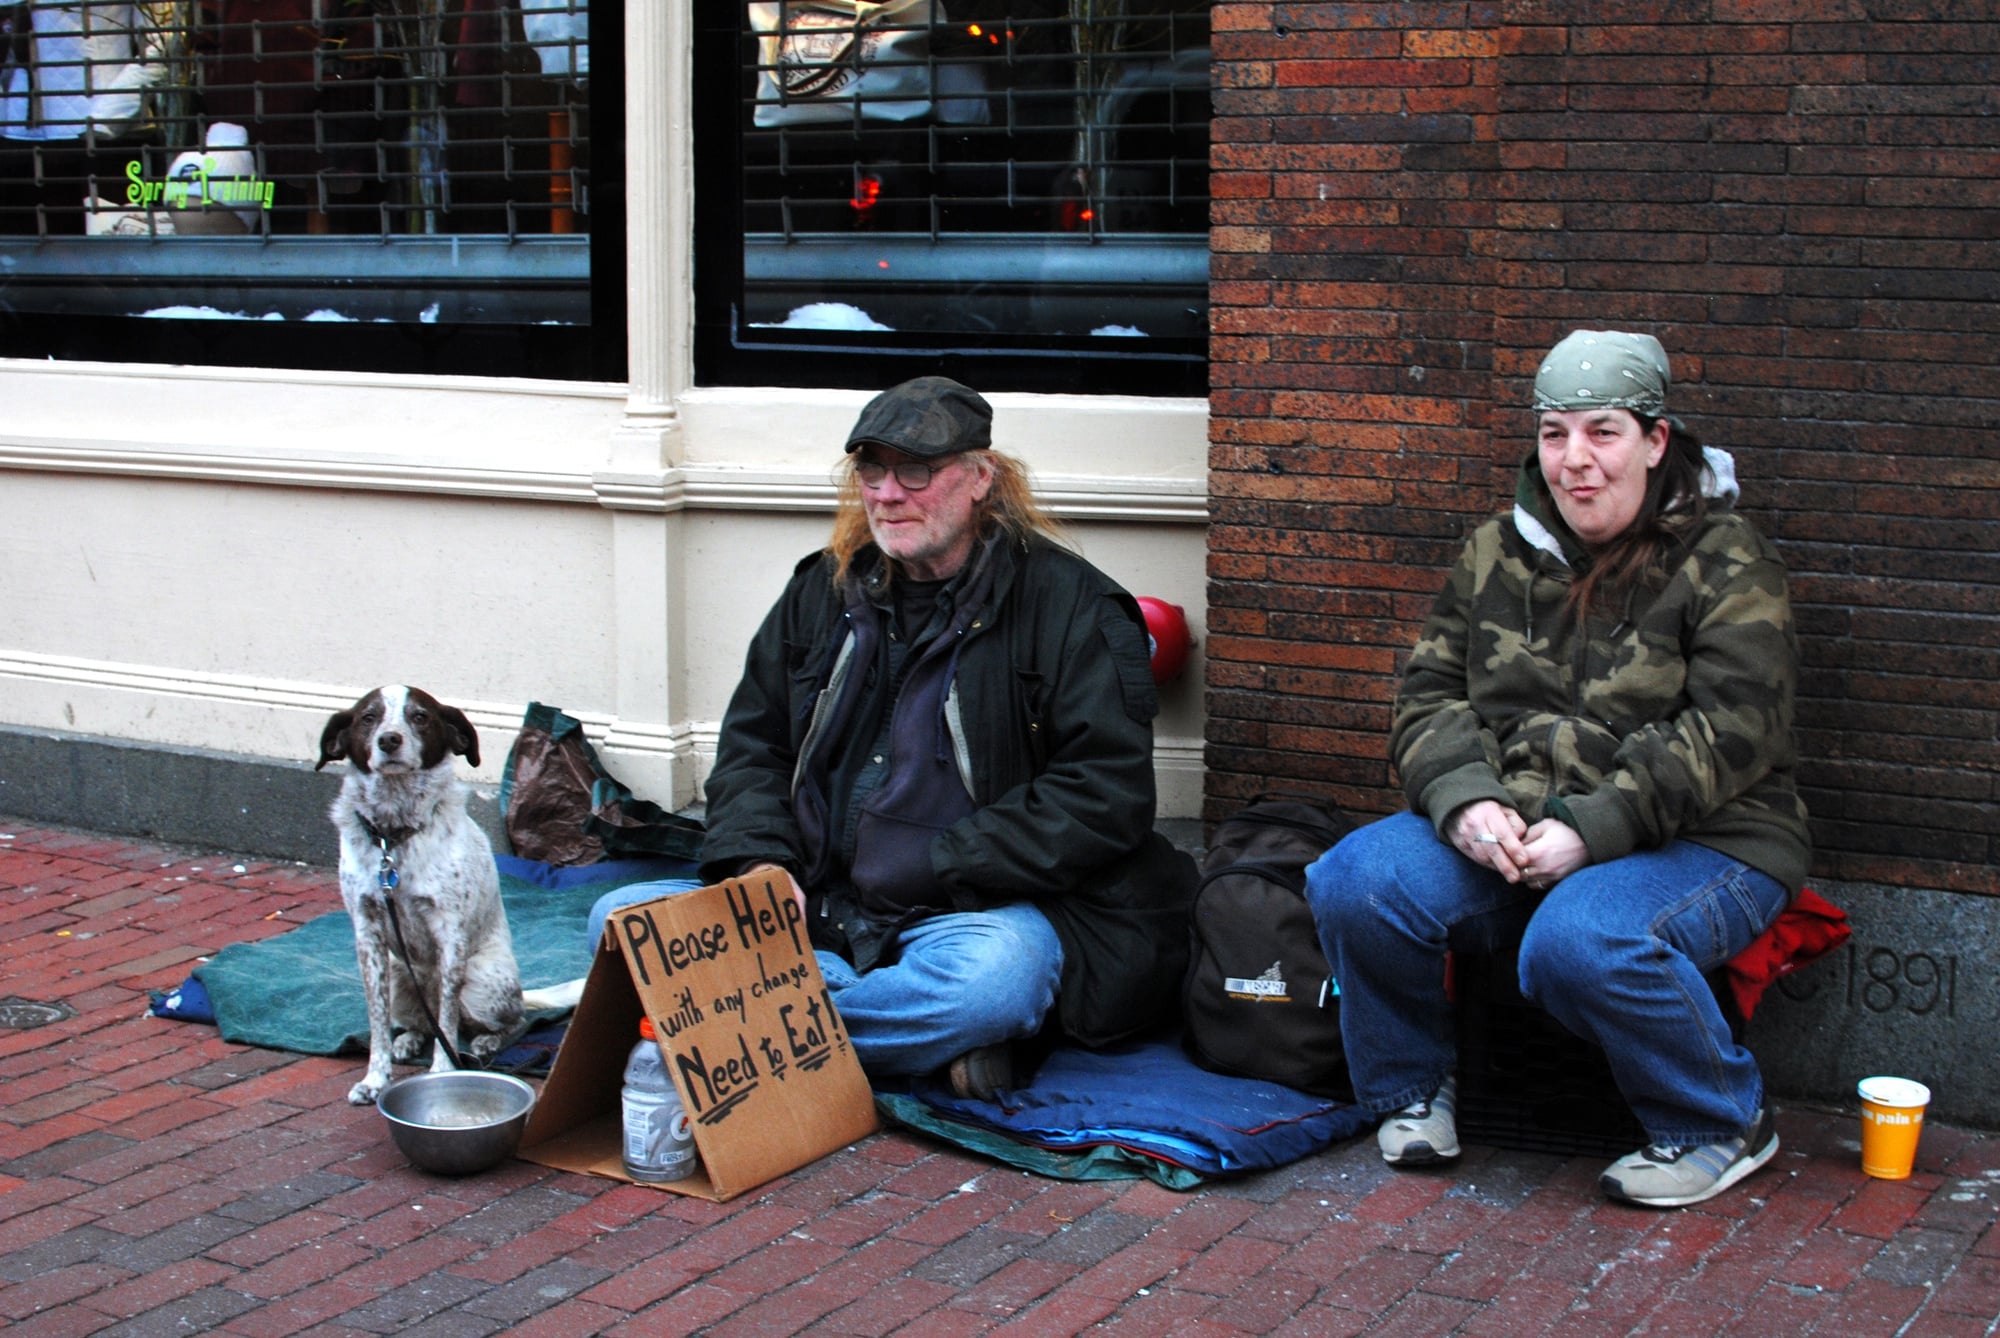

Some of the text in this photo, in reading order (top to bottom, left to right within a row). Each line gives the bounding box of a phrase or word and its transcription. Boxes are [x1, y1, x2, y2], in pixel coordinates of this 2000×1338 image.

[126, 157, 275, 209] Spring Training
[622, 881, 803, 986] Please Help
[659, 952, 809, 1038] with any change
[1846, 943, 1957, 1018] 1891
[676, 988, 844, 1113] Need to Eat!
[1875, 1112, 1910, 1126] pain
